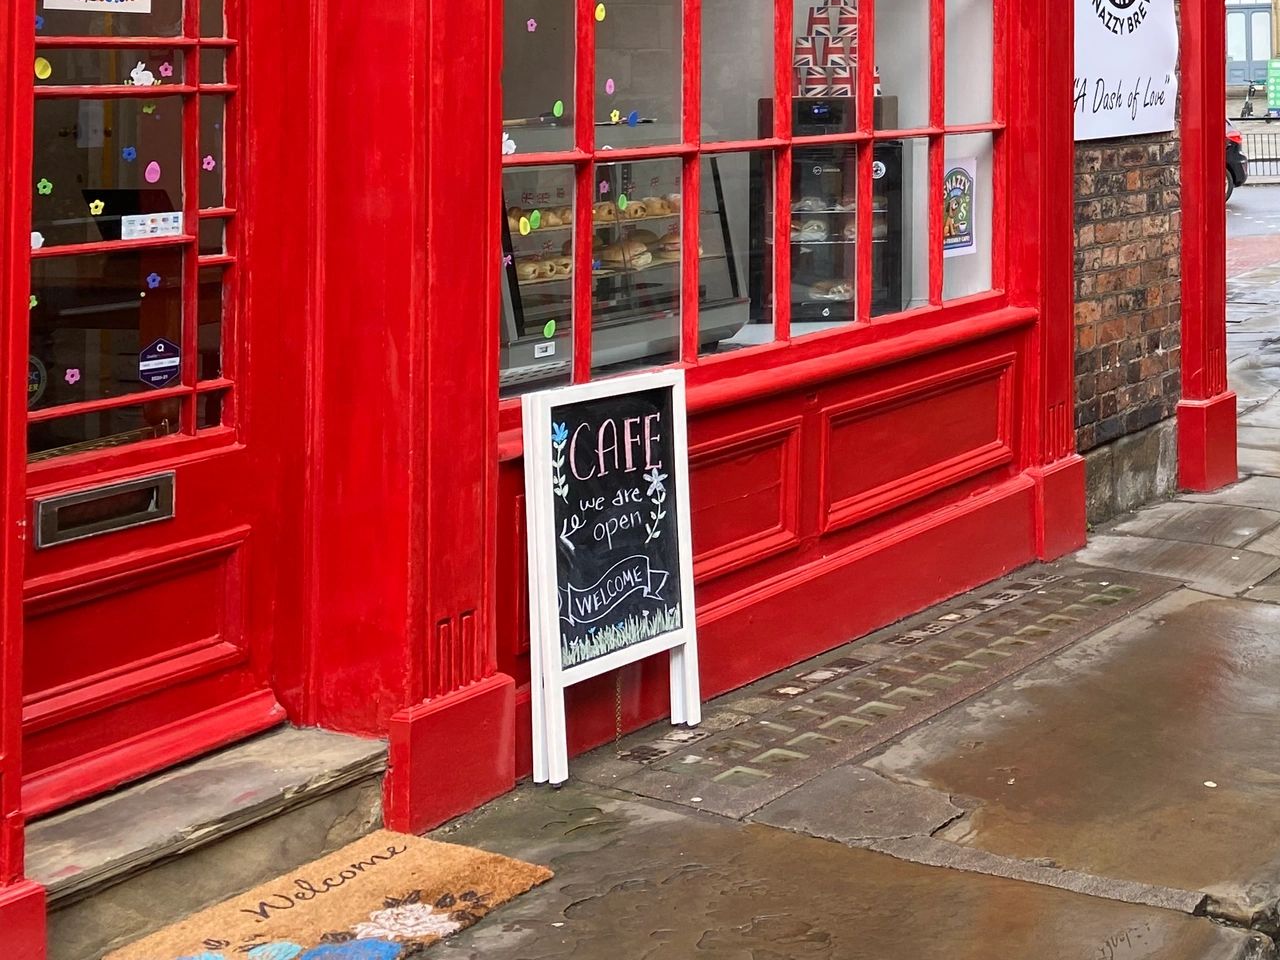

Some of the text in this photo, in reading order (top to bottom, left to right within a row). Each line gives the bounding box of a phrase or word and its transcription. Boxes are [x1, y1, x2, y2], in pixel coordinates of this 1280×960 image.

[1093, 78, 1122, 114] Dash
[1127, 76, 1140, 121] of
[569, 412, 662, 481] CAFE
[580, 488, 643, 512] we are
[593, 510, 642, 550] open
[575, 565, 643, 616] WELCOME
[240, 845, 407, 922] Welcome
